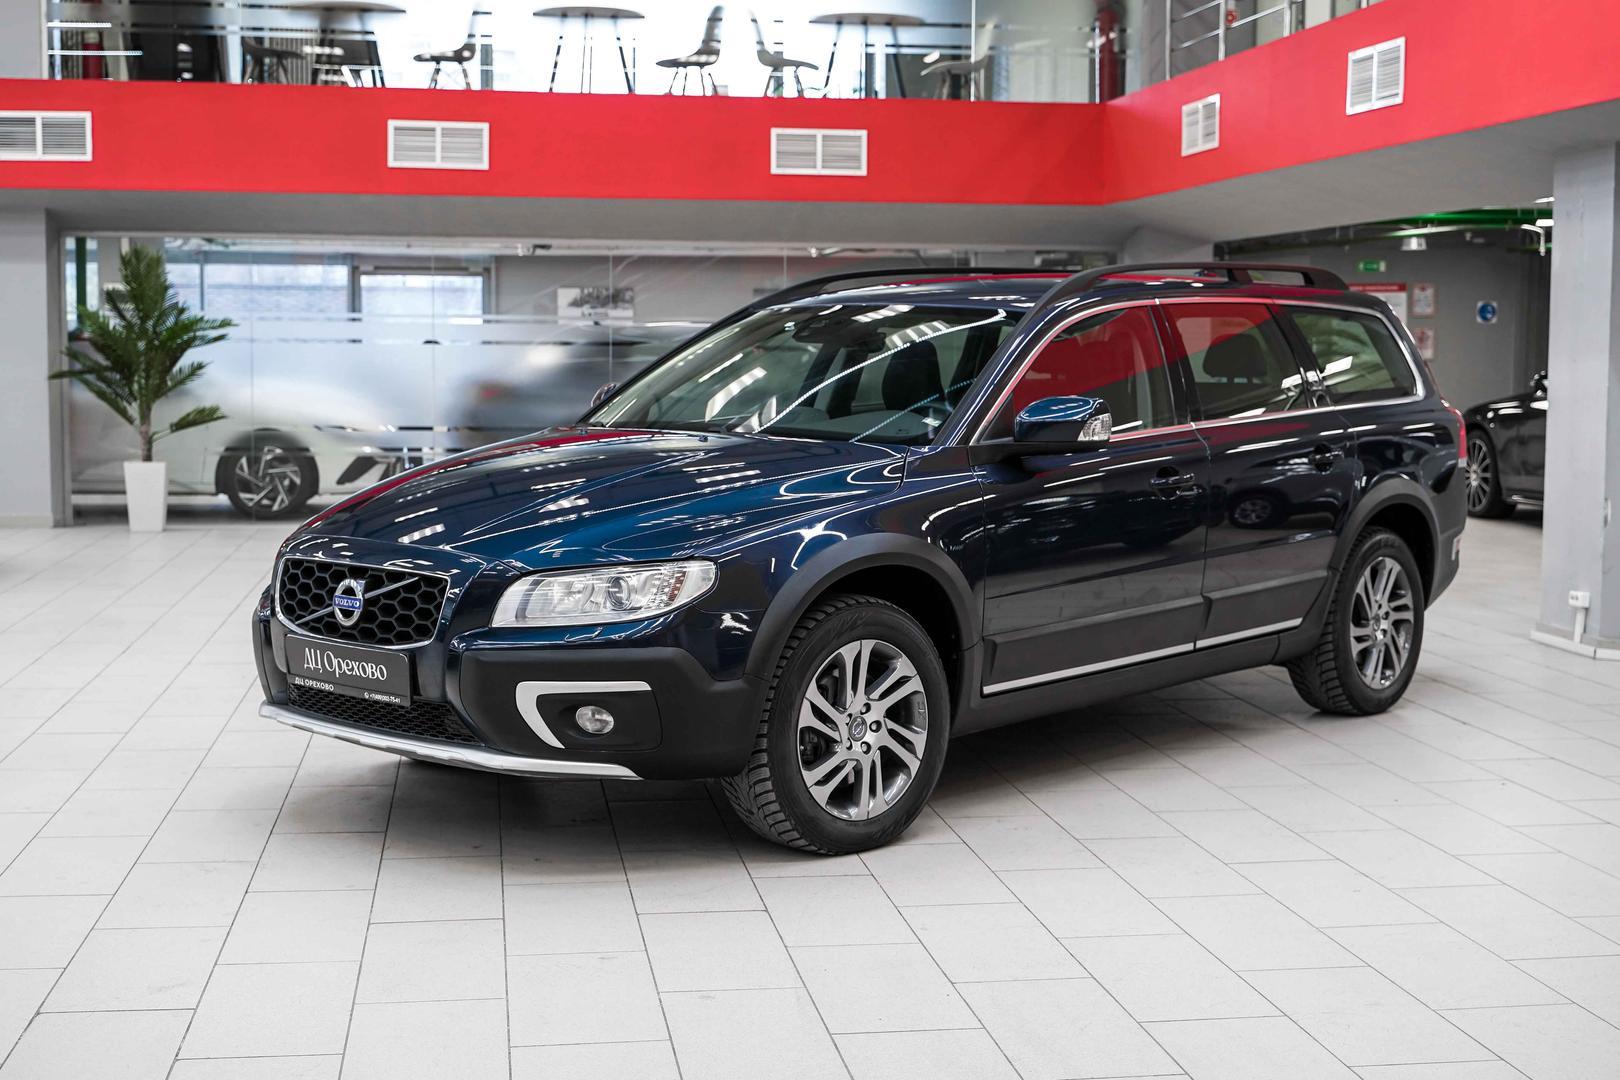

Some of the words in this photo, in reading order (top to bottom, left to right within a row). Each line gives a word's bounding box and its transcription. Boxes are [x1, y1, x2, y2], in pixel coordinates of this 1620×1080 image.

[334, 598, 360, 608] VOLVO
[304, 648, 322, 673] ДЦ
[324, 651, 387, 681] Орехово
[295, 677, 304, 685] ДЦ
[304, 679, 334, 691] ОРЕХОВО
